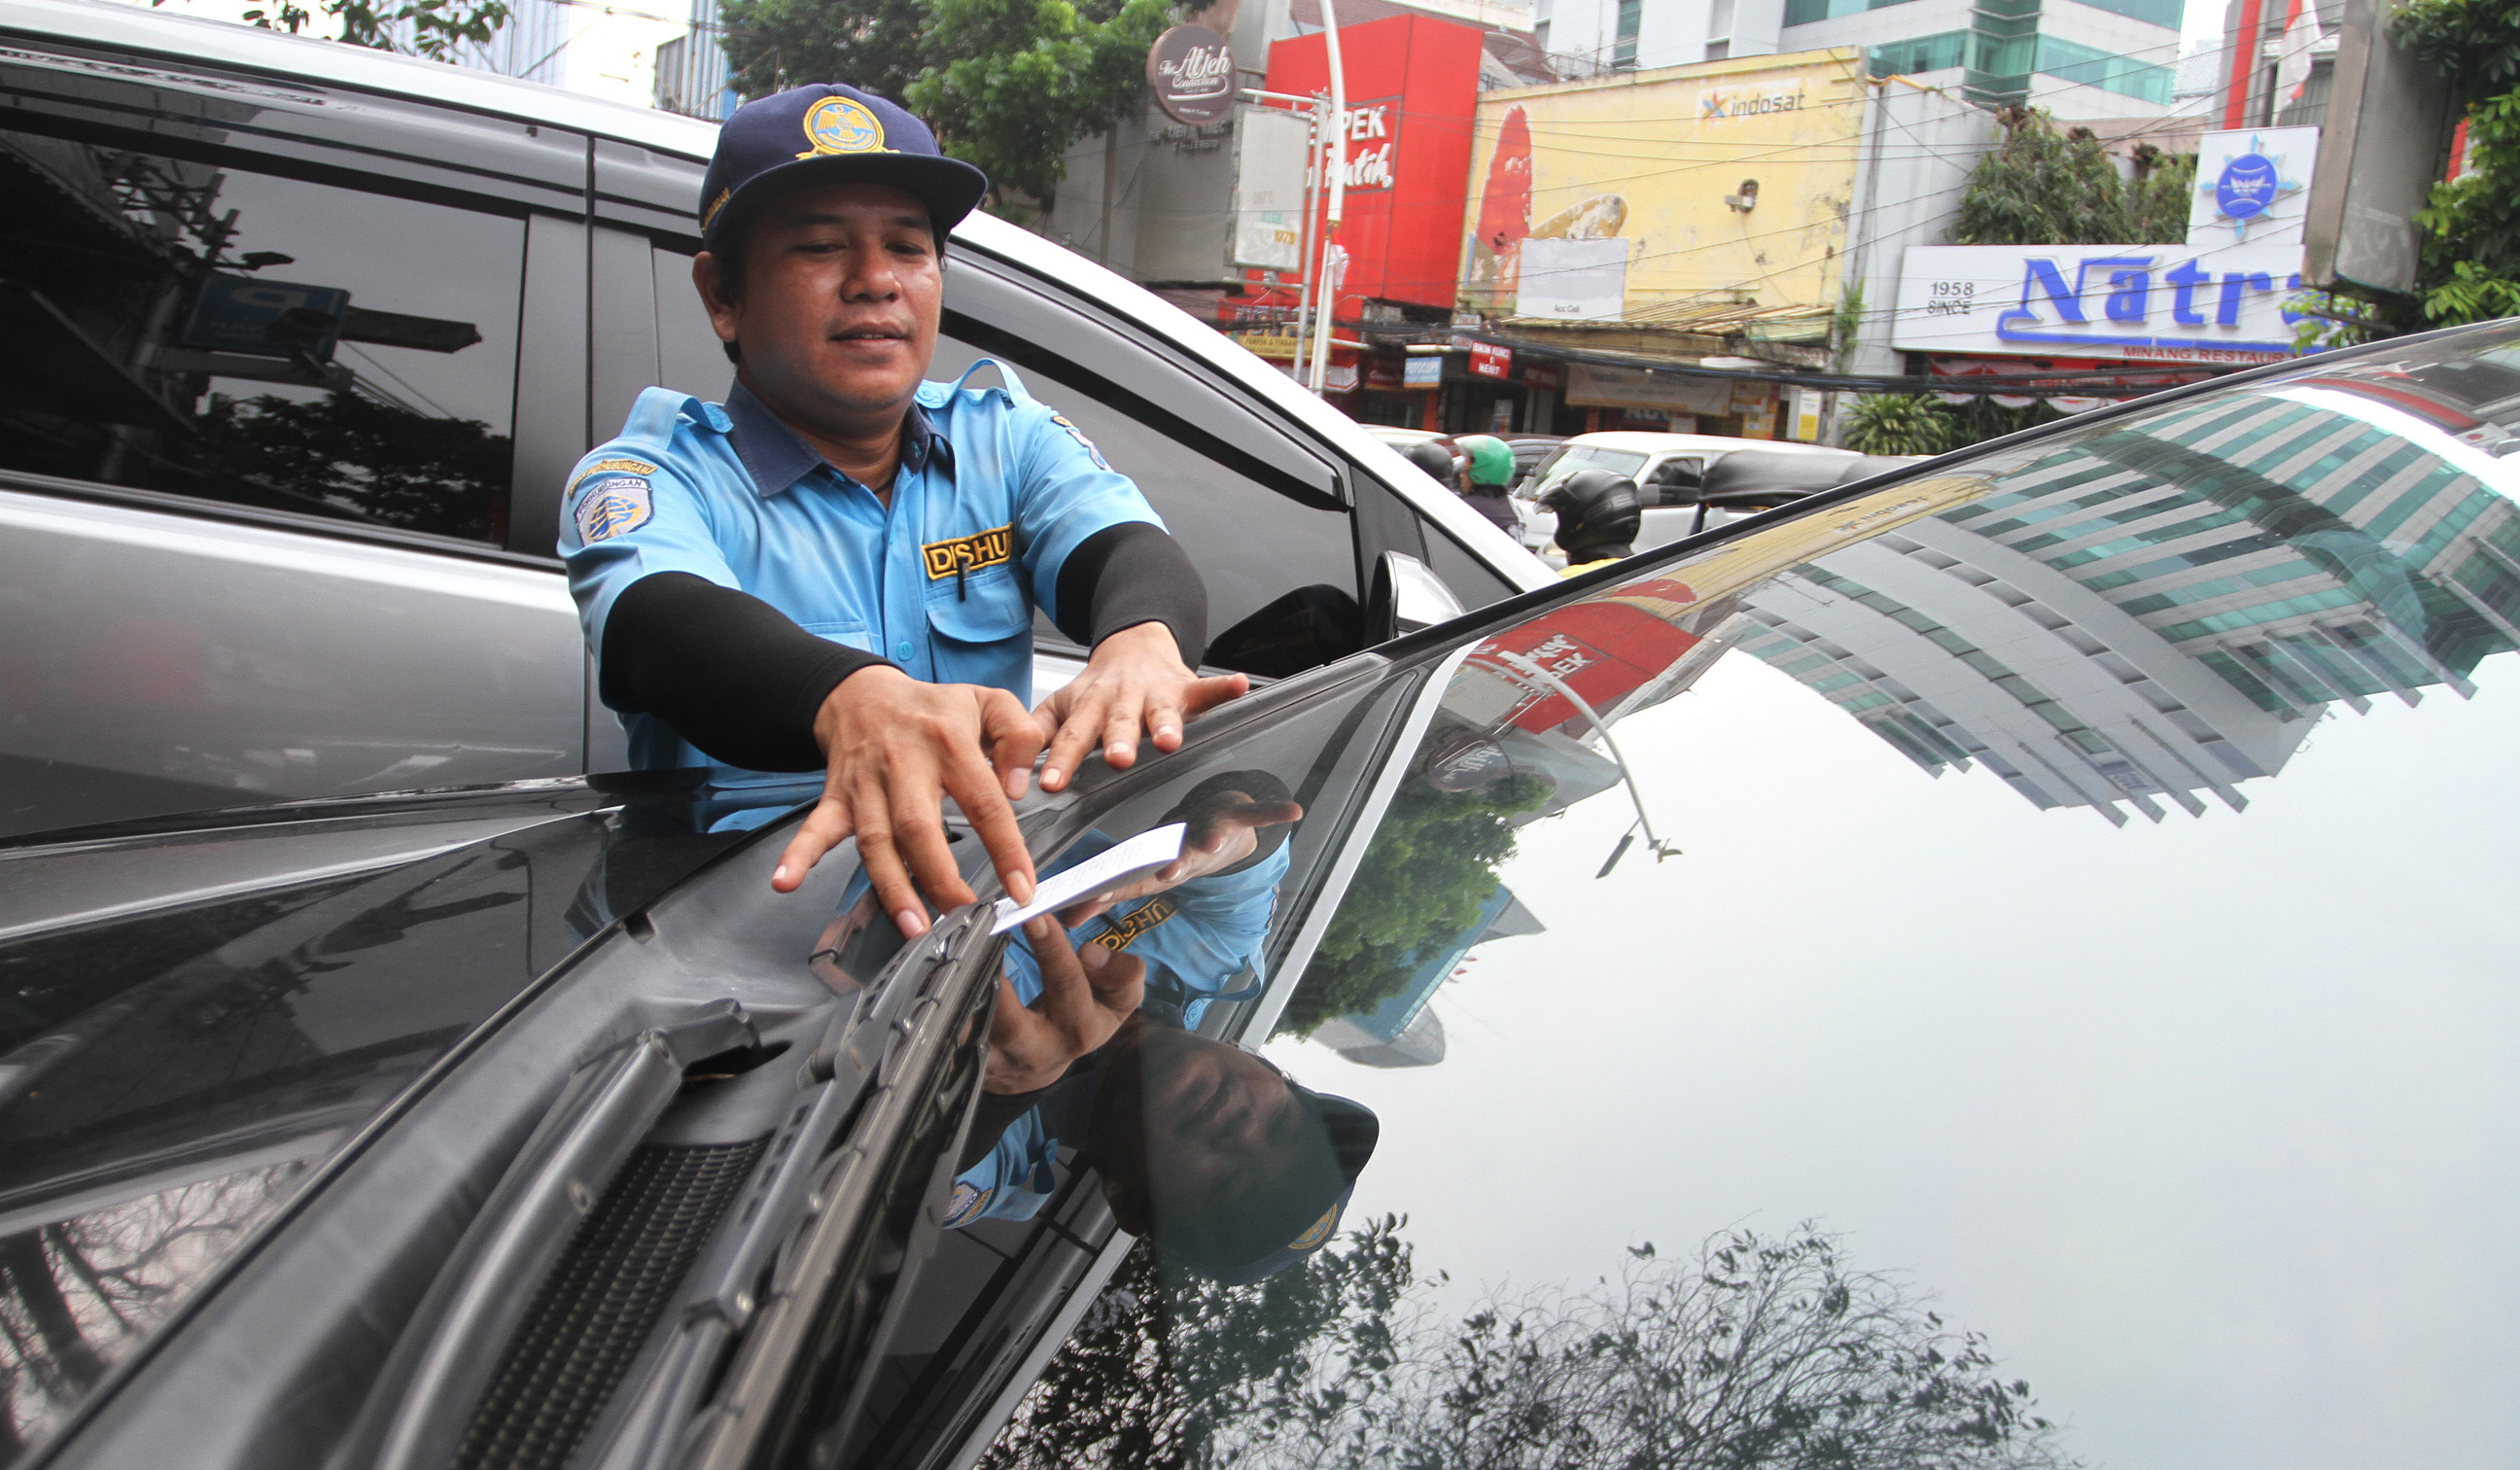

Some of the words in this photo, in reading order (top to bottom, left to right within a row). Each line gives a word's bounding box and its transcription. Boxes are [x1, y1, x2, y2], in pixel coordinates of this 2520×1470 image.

[1159, 59, 1177, 76] The
[1175, 46, 1231, 79] Atjeh
[1731, 88, 1805, 117] indosat
[1930, 281, 1974, 296] 1958
[1927, 299, 1972, 315] SINCE
[2122, 346, 2191, 361] MINANG
